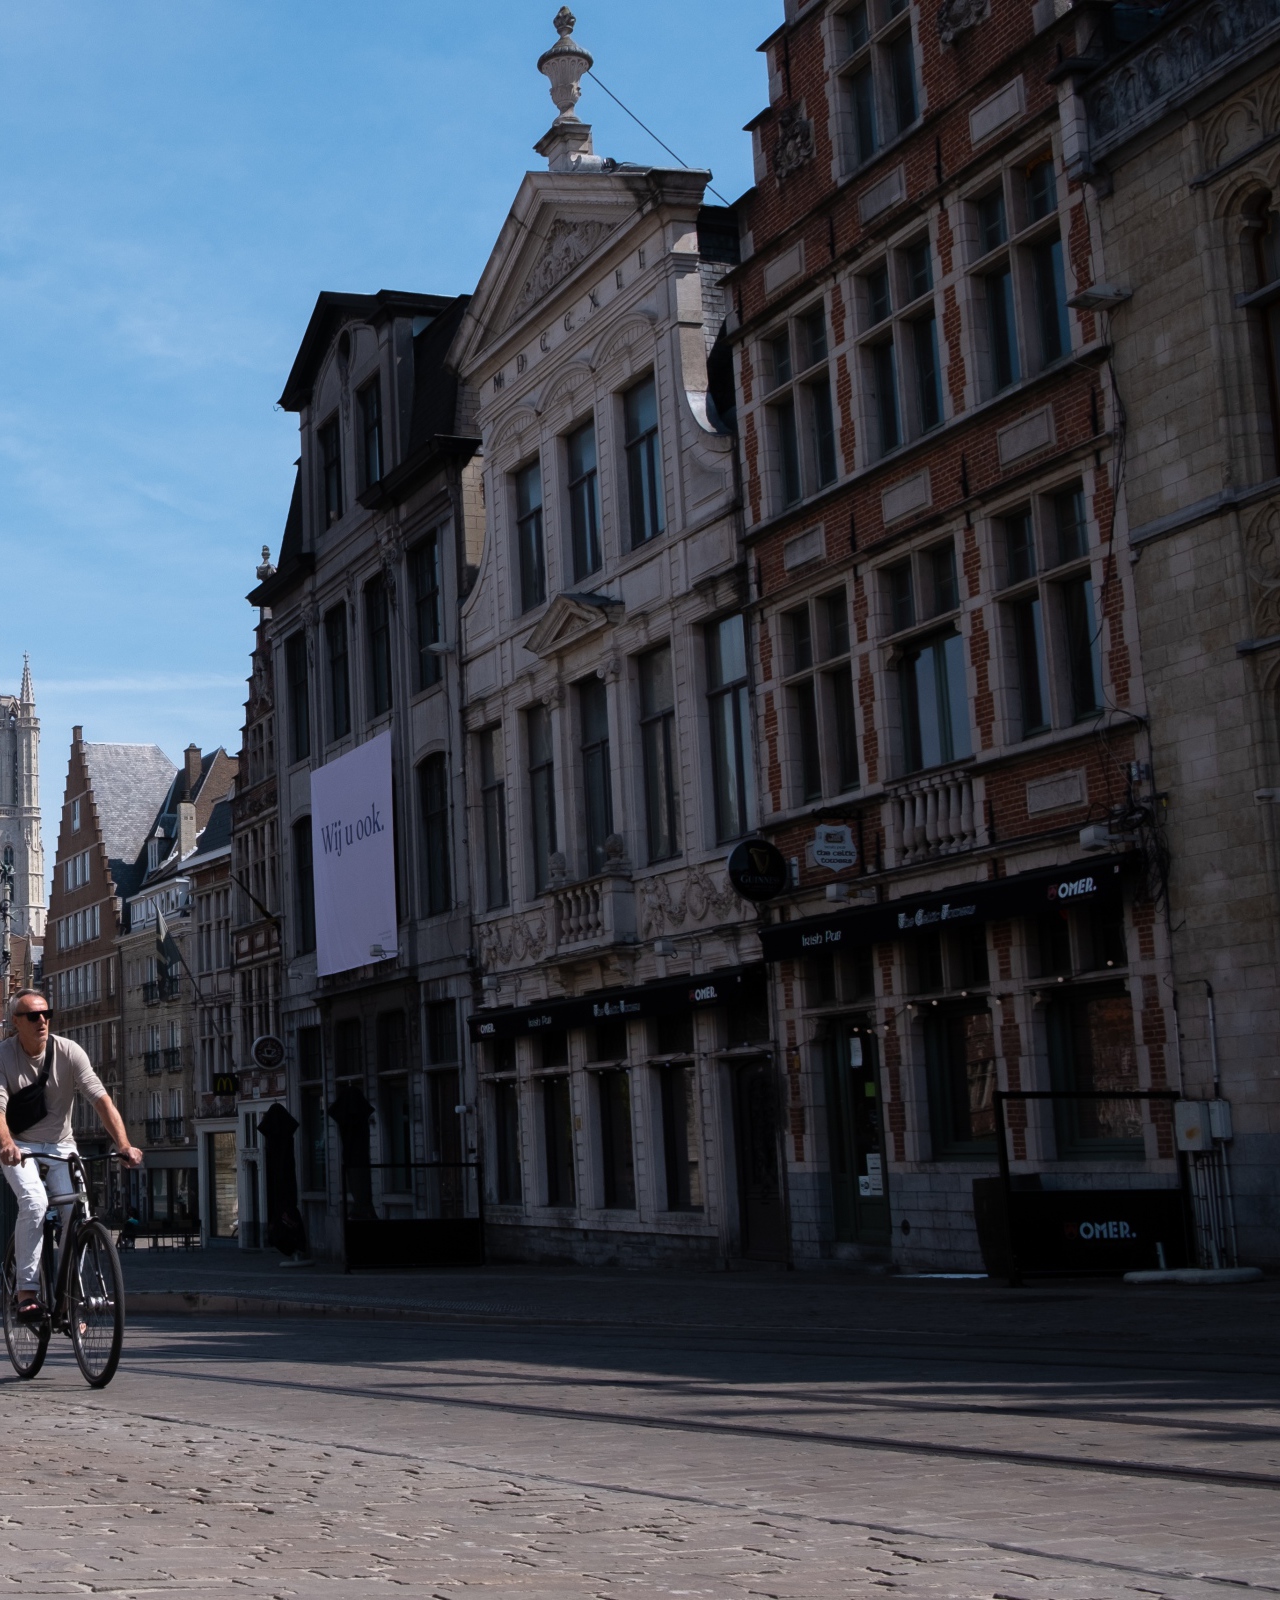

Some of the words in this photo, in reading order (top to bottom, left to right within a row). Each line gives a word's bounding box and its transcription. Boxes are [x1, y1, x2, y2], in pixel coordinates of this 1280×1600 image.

[321, 819, 341, 857] Wij
[345, 823, 353, 846] u
[356, 801, 384, 841] ook.
